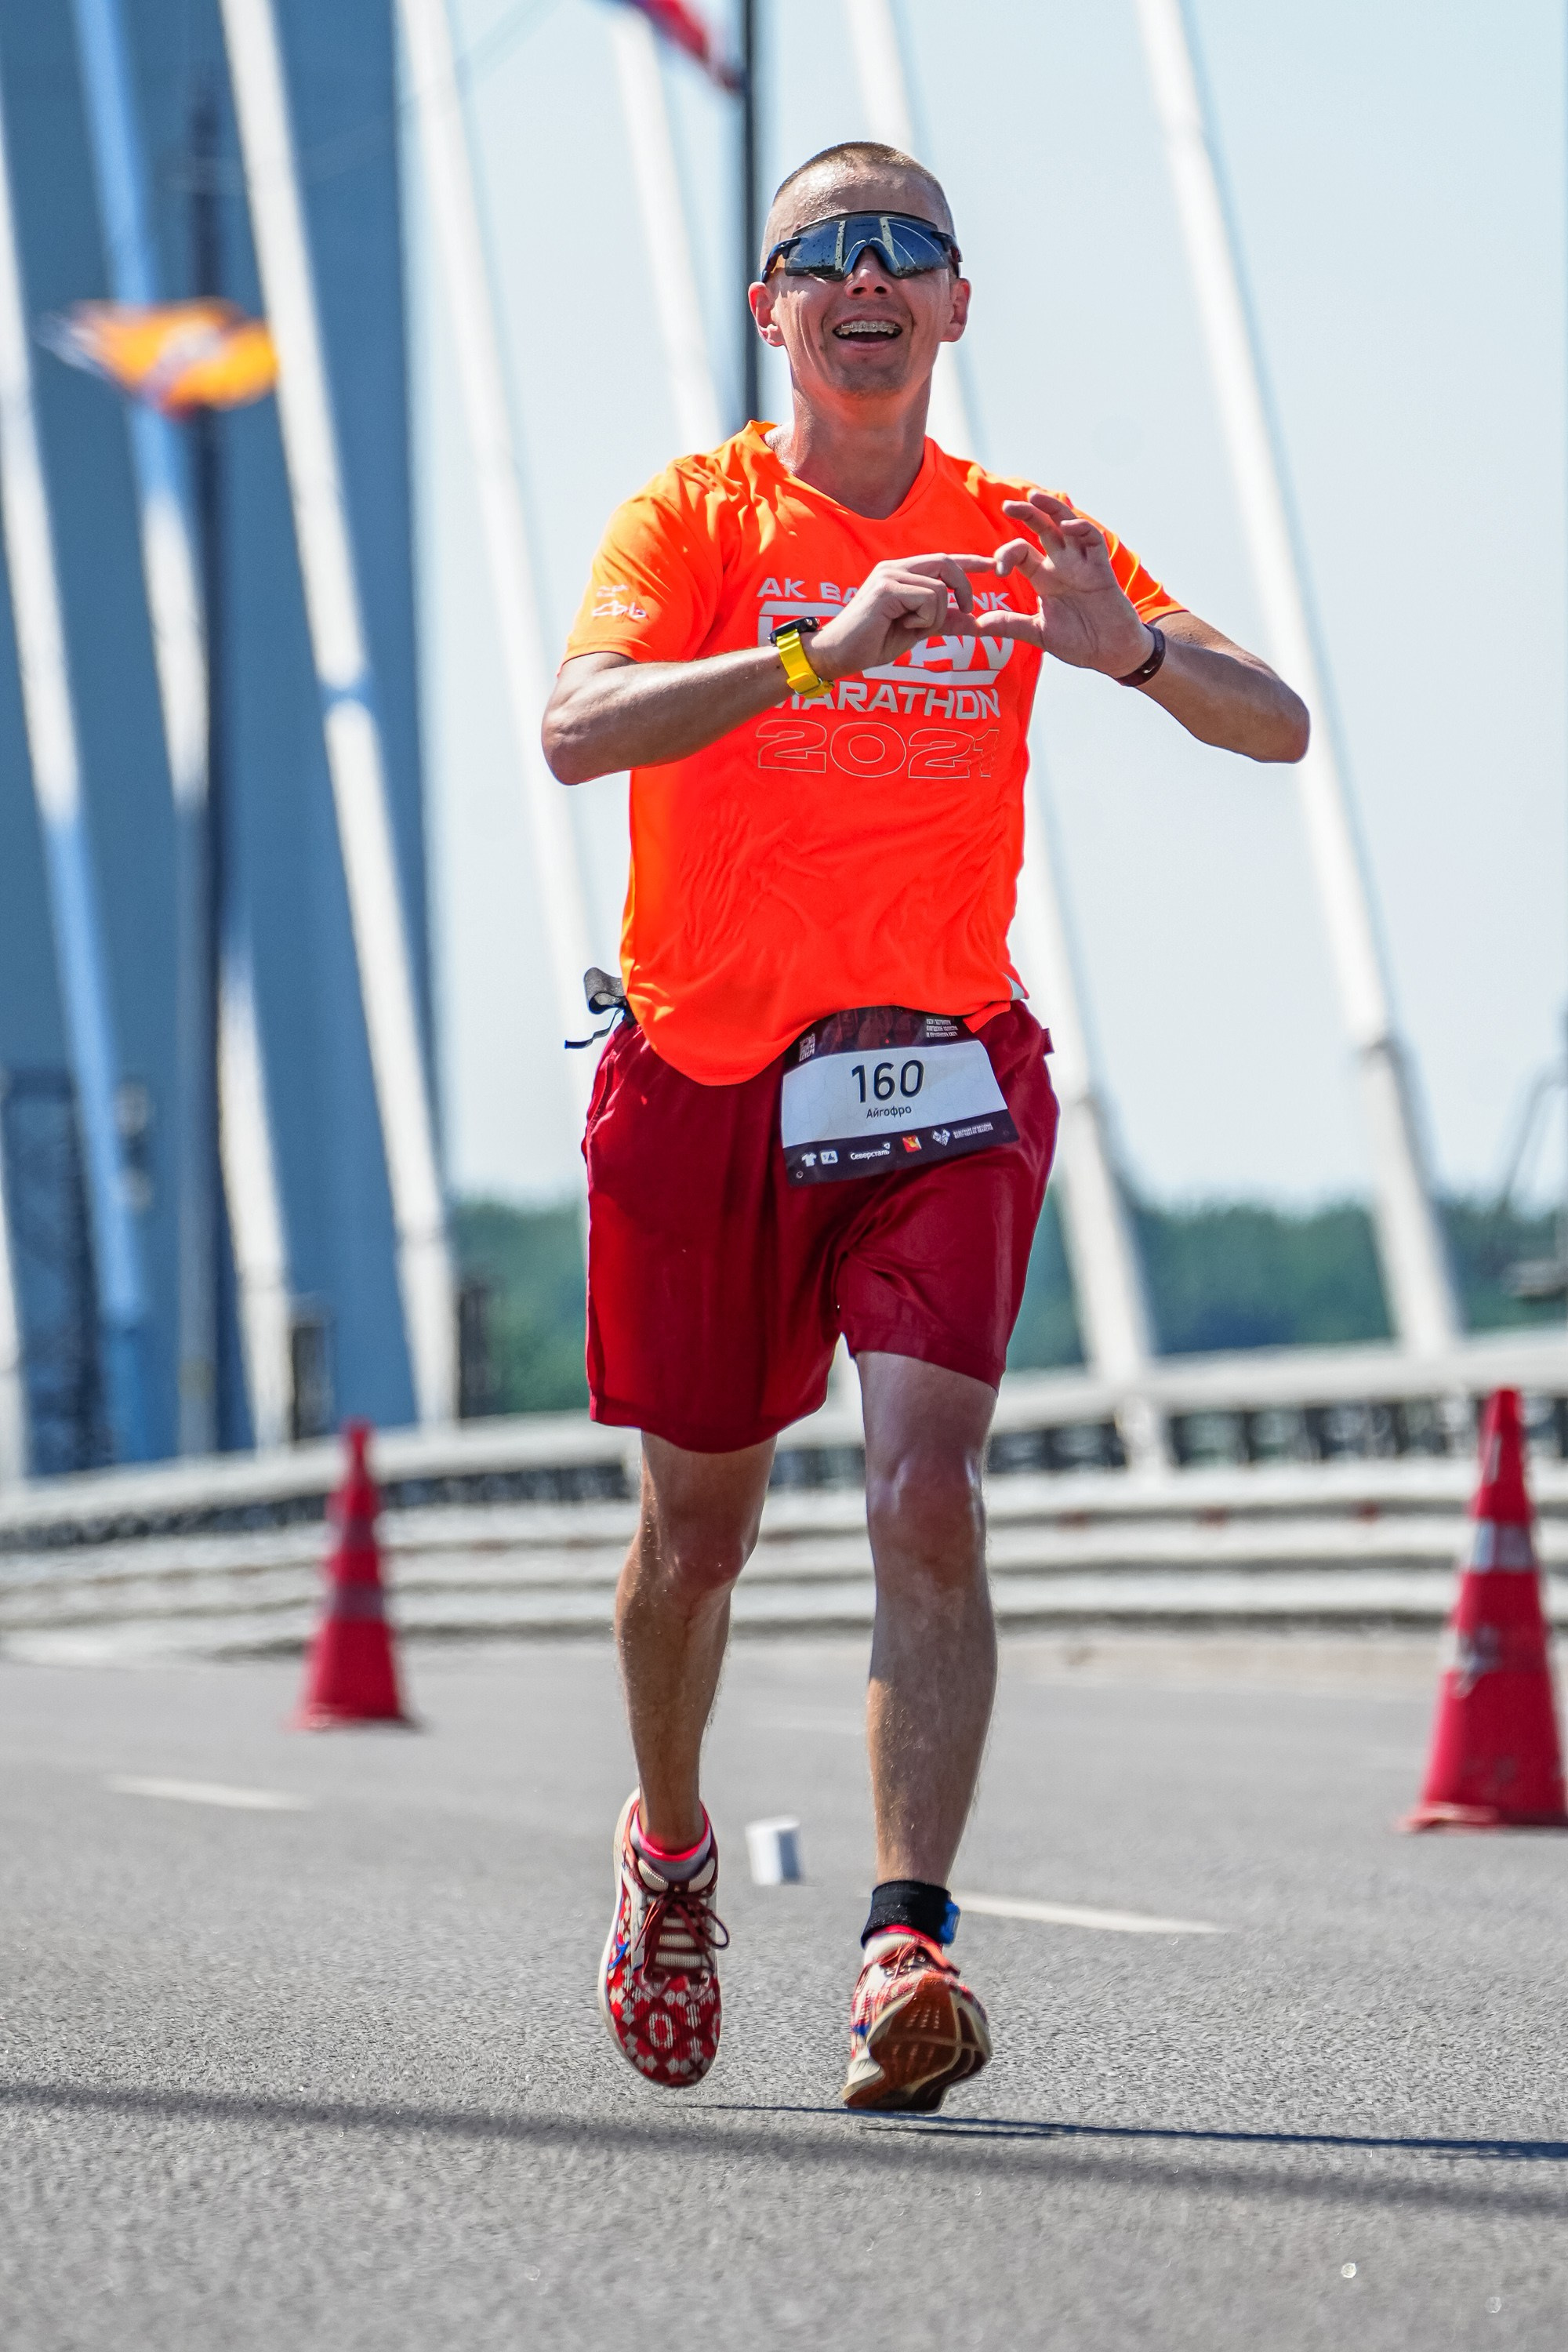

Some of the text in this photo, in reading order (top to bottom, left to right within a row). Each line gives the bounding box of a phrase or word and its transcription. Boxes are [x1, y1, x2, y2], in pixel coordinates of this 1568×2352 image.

[757, 577, 1014, 611] AK BA ANK
[775, 681, 1001, 719] ARATHON
[755, 719, 1000, 780] 2021
[851, 1059, 924, 1103] 160
[866, 1105, 913, 1120] Айгофро
[850, 1149, 890, 1160] Северсталь
